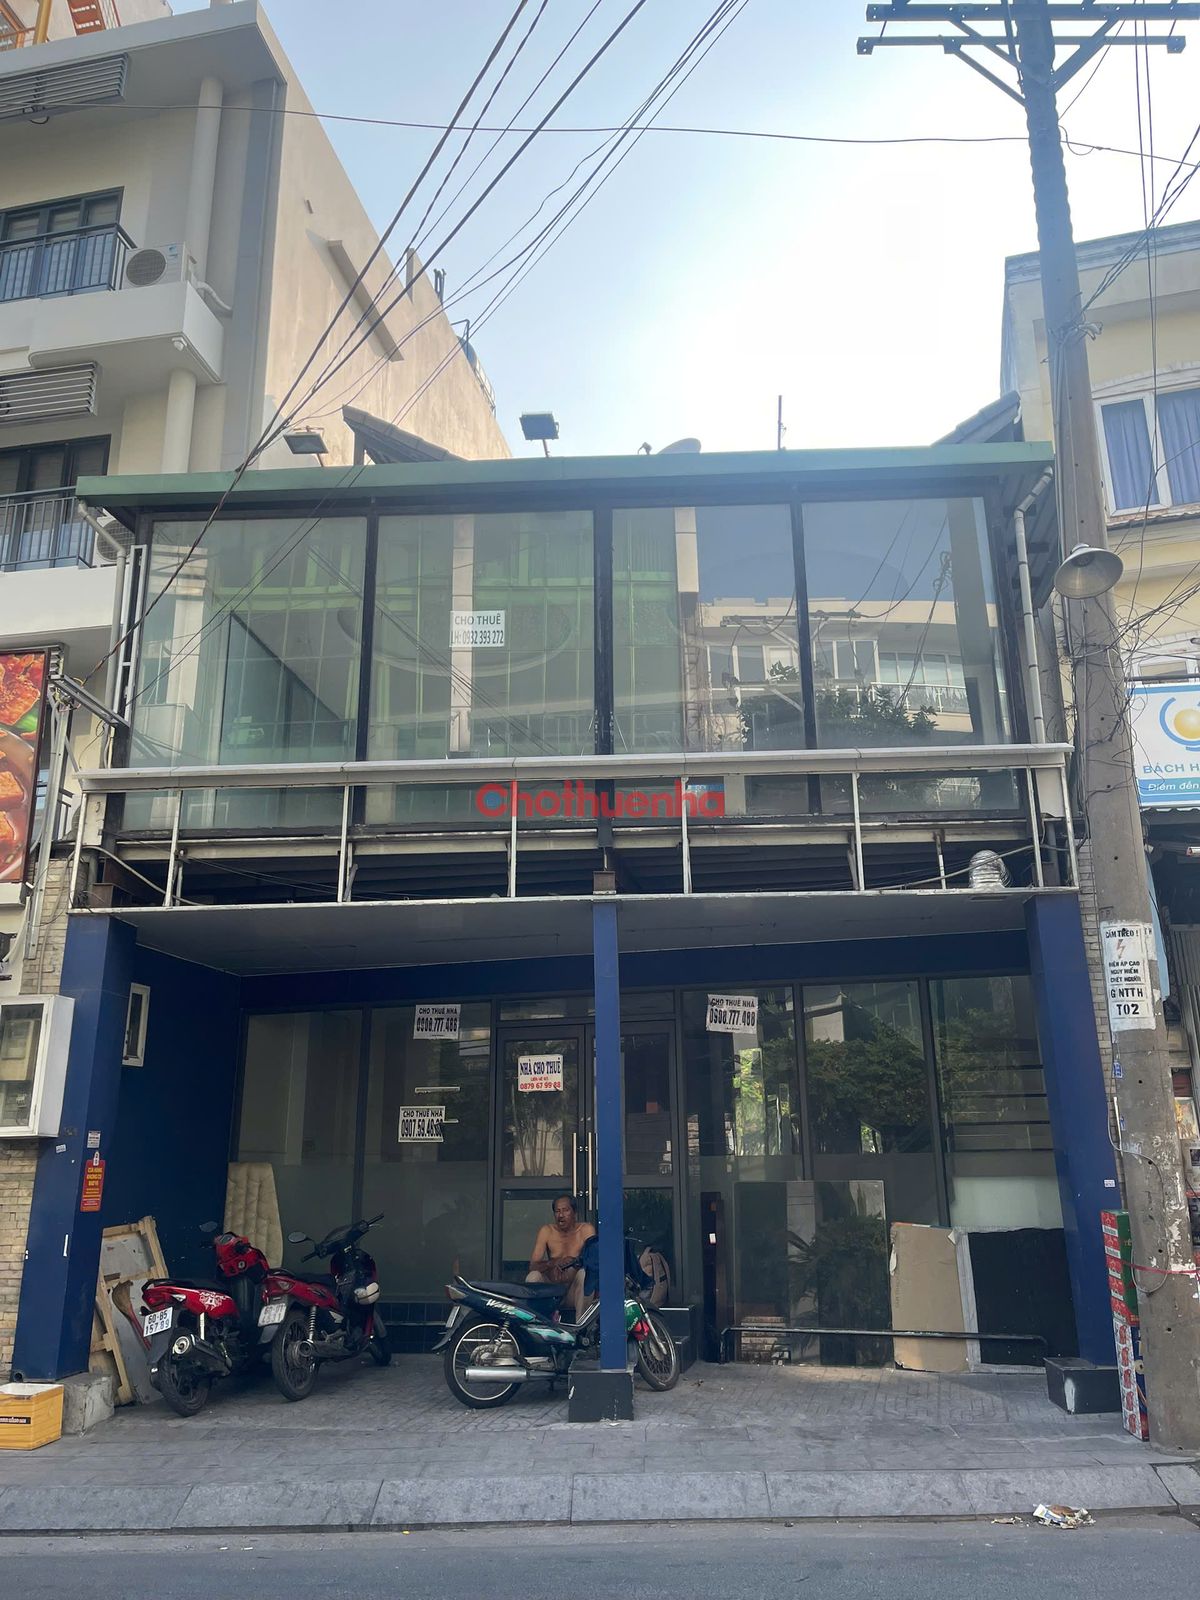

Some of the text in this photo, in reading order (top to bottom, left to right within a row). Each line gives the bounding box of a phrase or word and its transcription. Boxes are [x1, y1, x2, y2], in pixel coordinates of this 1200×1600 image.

[455, 613, 501, 625] CHO THUÊ
[463, 630, 478, 644] 0932
[480, 630, 491, 644] 393
[492, 630, 504, 644] 272
[1143, 762, 1185, 774] BÁCH
[520, 1059, 532, 1075] NHÀ
[533, 1061, 545, 1075] CHO
